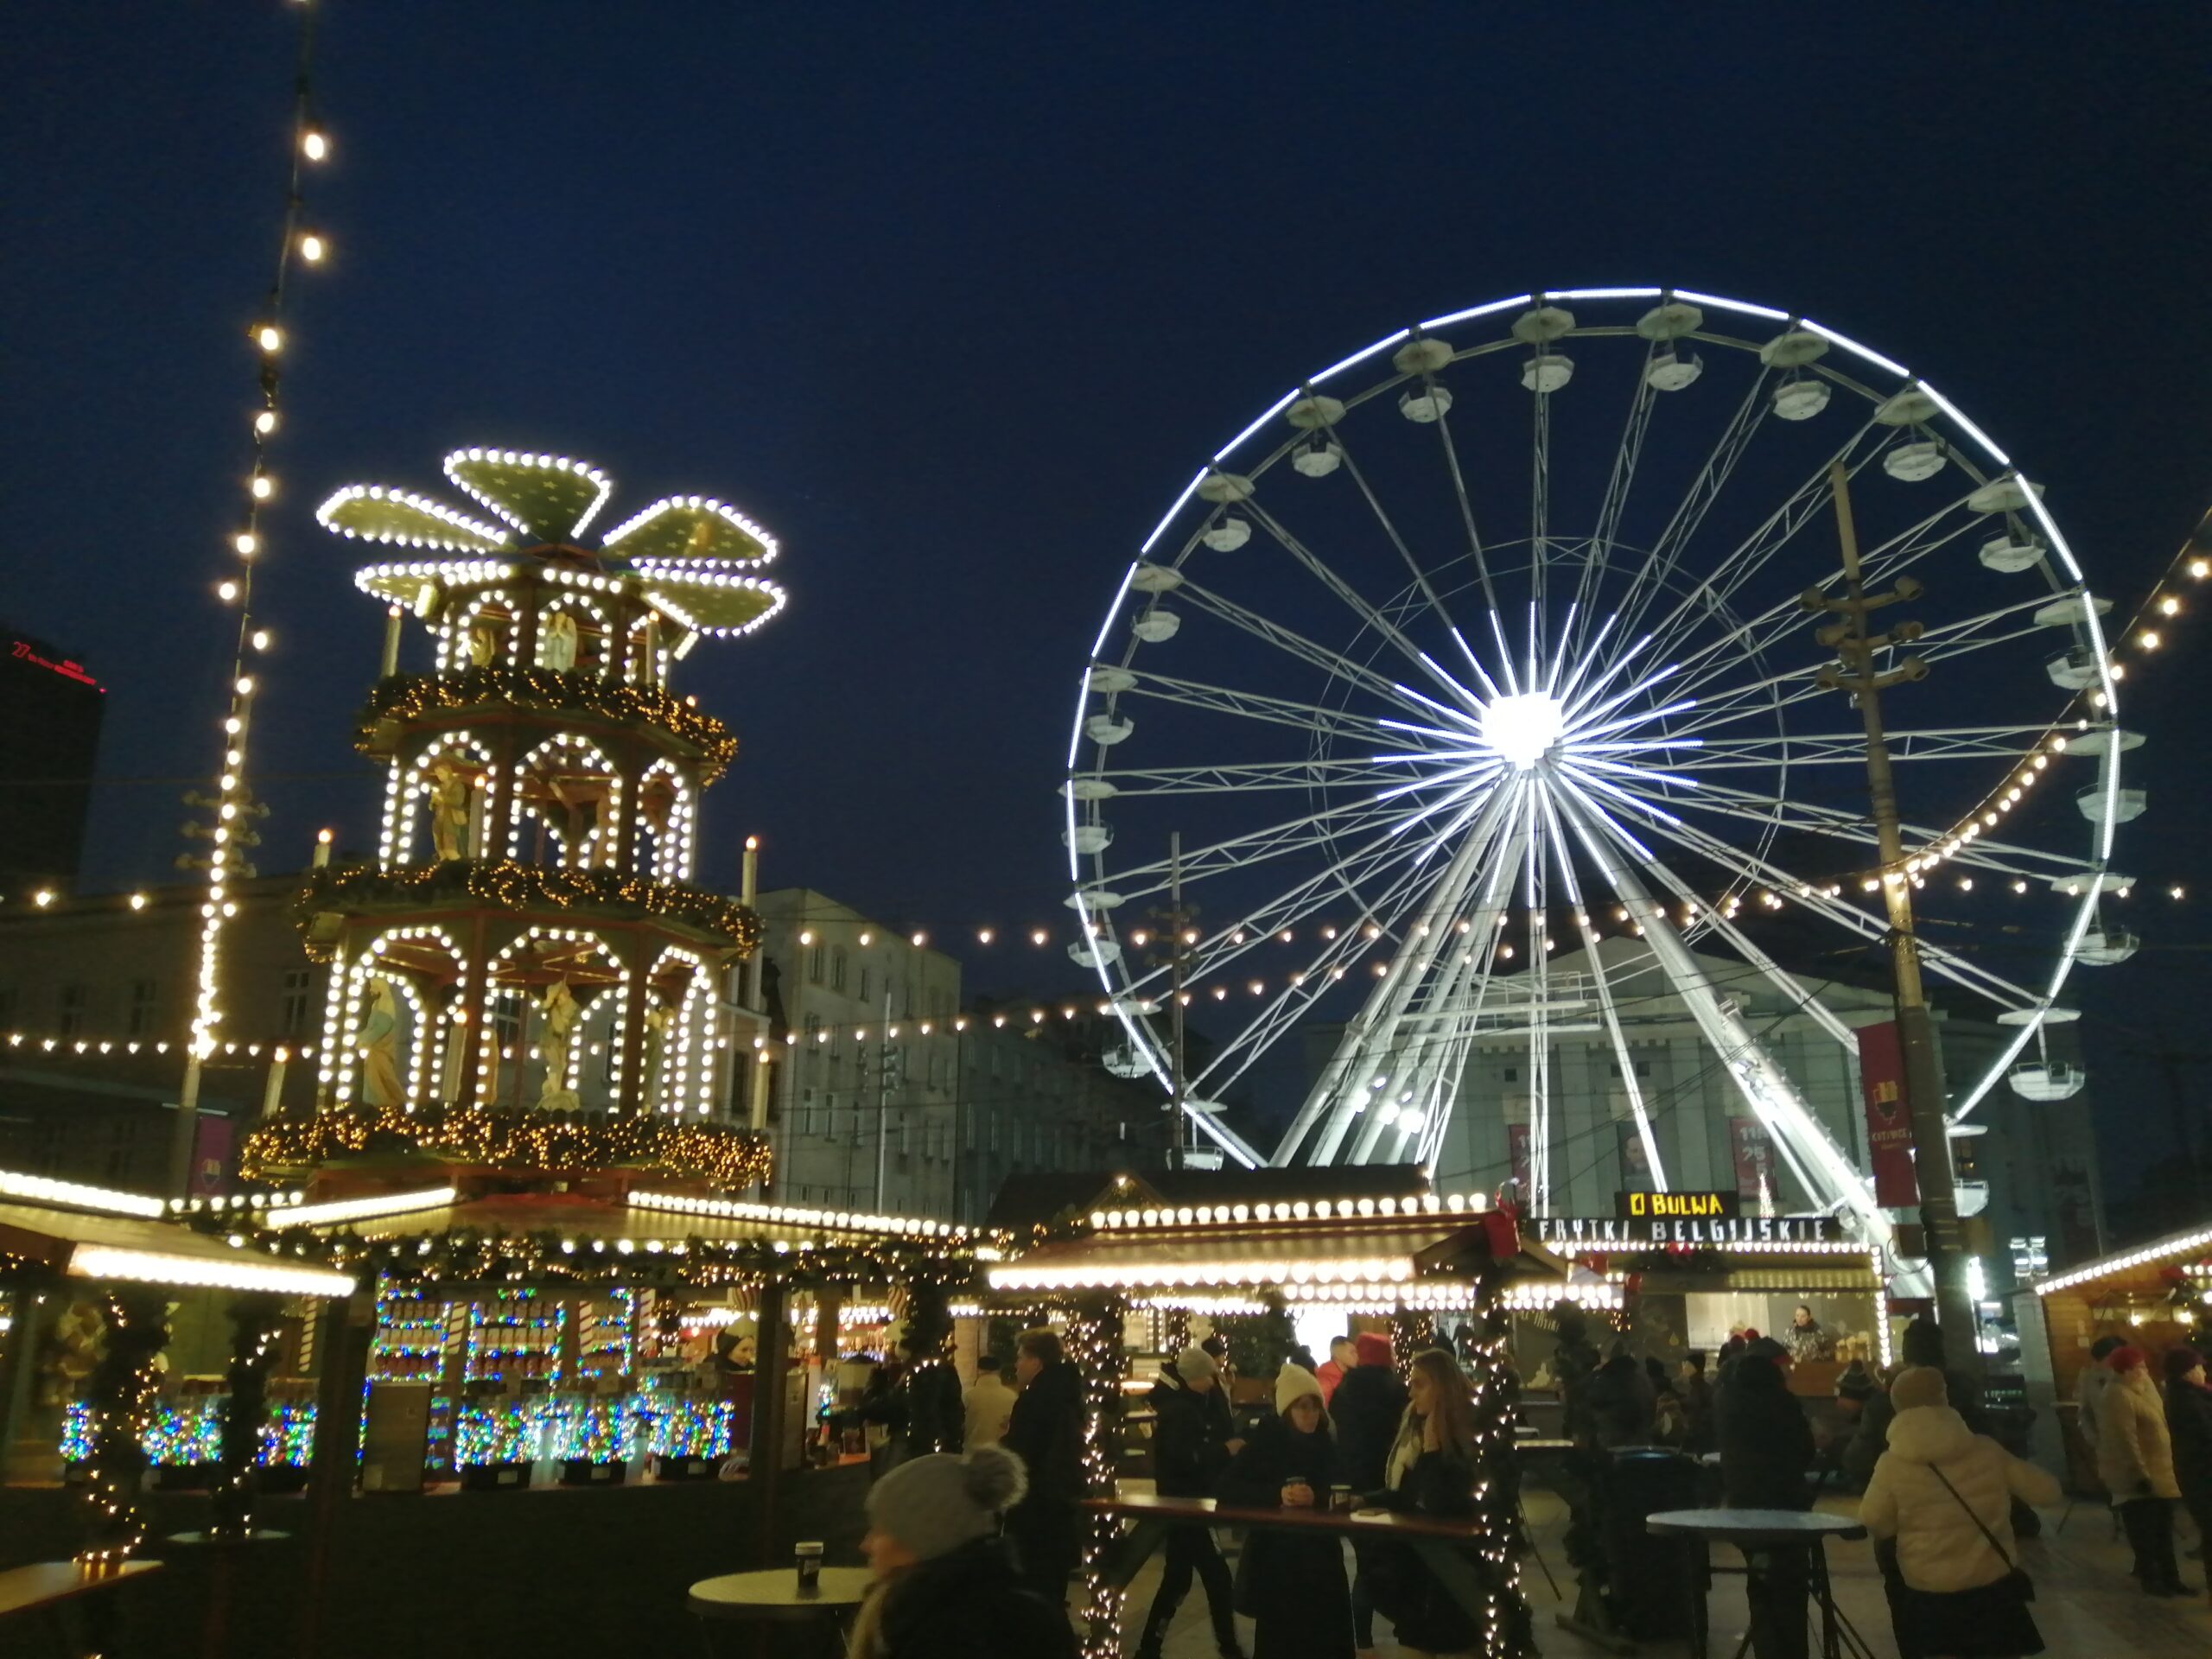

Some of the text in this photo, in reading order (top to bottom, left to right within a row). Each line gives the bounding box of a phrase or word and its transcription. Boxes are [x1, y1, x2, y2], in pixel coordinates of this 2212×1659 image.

[1651, 1193, 1723, 1216] BULWA
[1539, 1217, 1825, 1242] FRYTKI BELGIJSKIE
